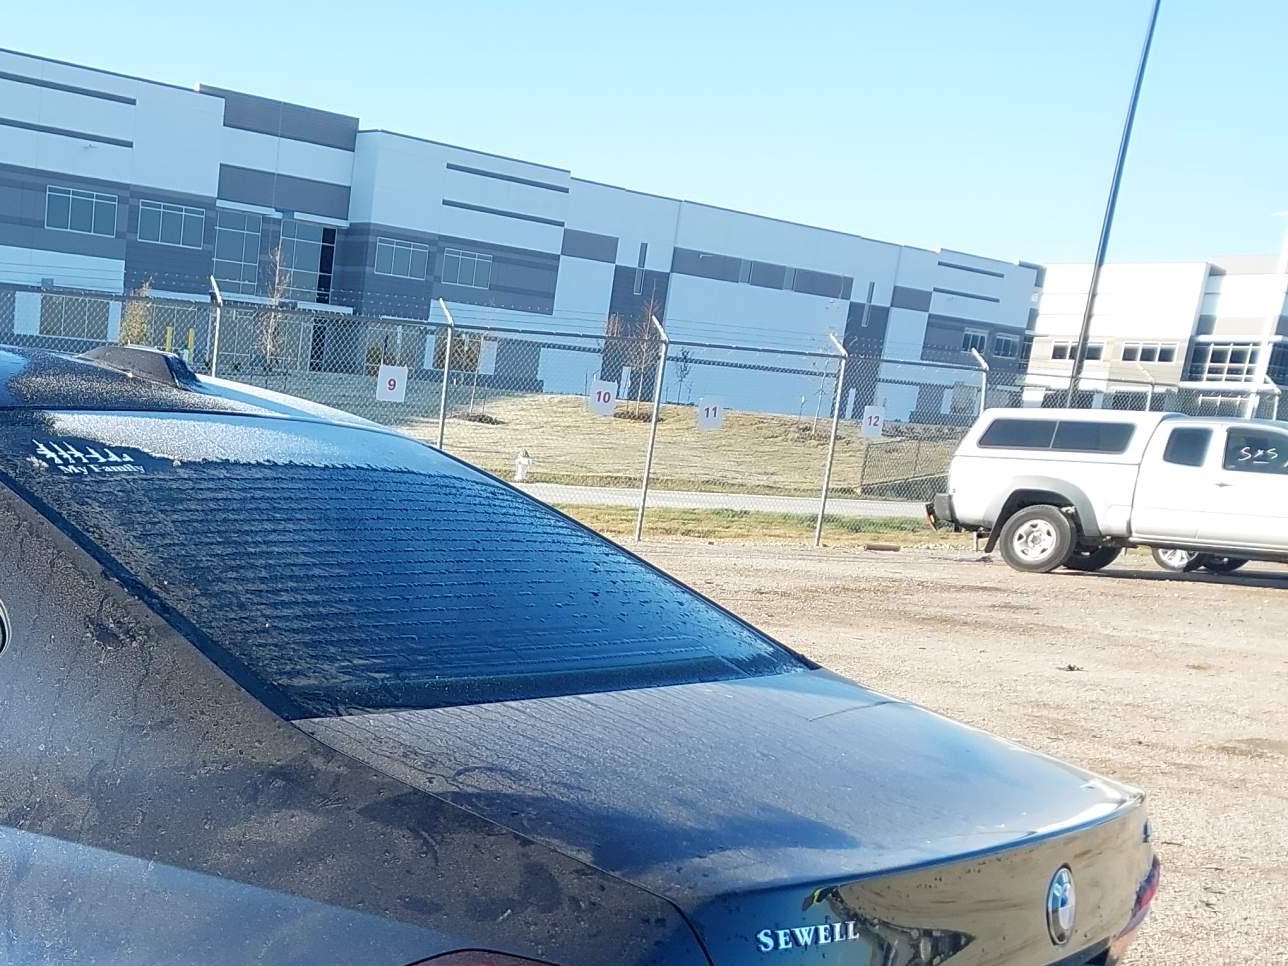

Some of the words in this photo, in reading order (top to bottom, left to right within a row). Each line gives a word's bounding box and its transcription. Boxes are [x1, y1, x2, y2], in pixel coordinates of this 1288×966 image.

[387, 378, 397, 391] 9
[596, 390, 611, 404] 10
[704, 406, 718, 419] 11
[867, 415, 880, 427] 12
[57, 465, 89, 475] My
[87, 463, 146, 474] Family
[756, 920, 860, 952] SEWELL
